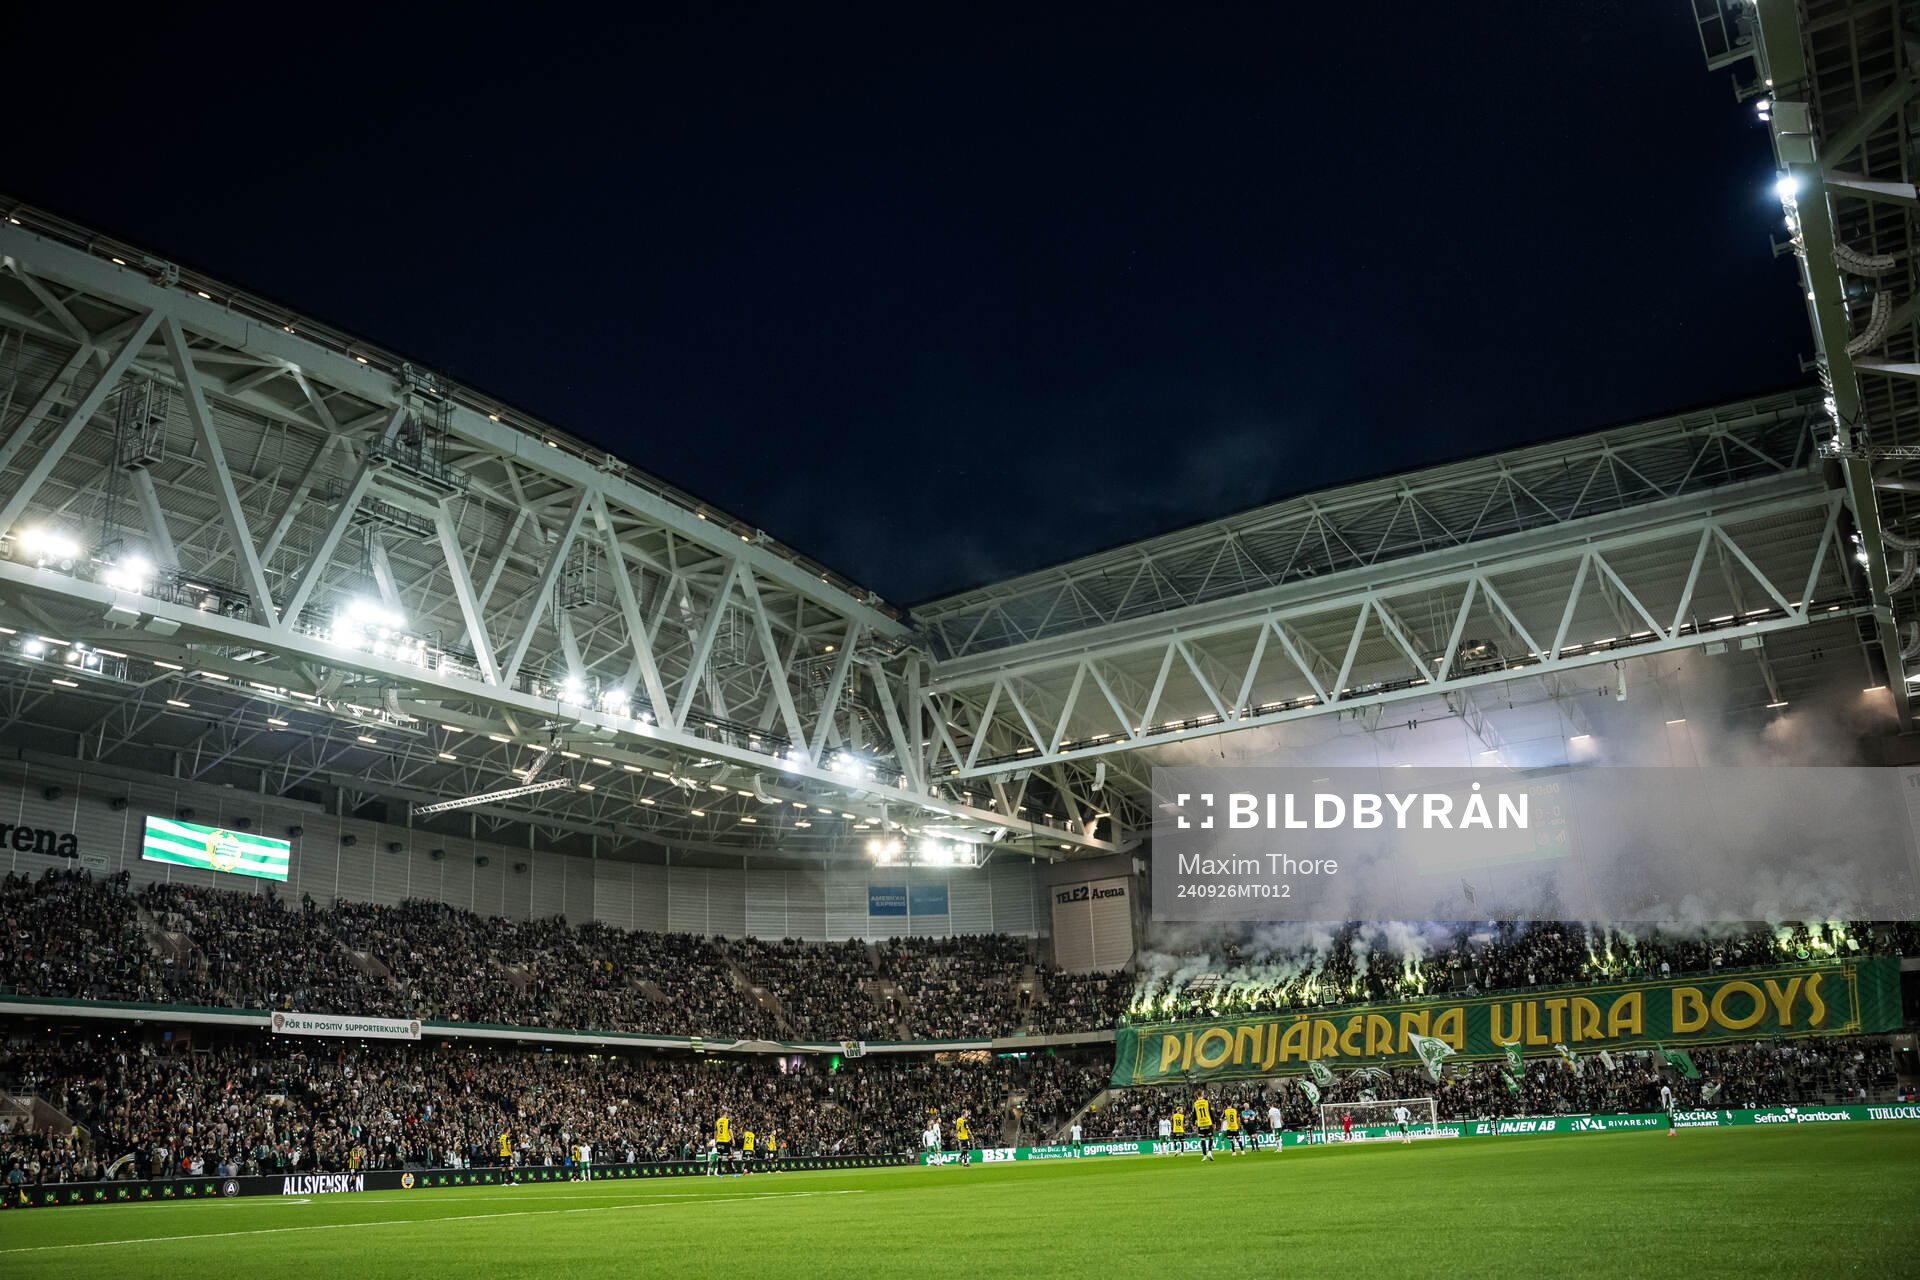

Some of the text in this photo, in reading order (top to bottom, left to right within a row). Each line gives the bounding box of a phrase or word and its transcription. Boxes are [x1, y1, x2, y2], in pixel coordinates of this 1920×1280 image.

[1056, 886, 1125, 904] TELE2 Arena
[285, 1019, 409, 1034] FÖR EN POSITIV SUPPORTERKULTUR
[1159, 972, 1826, 1074] PIONJÄRERNA ULTRA BOYS
[1198, 1107, 1207, 1118] 11
[1673, 1111, 1718, 1121] SASCHAS
[1754, 1109, 1851, 1124] Sefina pantbank
[1476, 1121, 1537, 1134] ELINJEN
[1538, 1120, 1556, 1131] AB
[1608, 1118, 1657, 1127] RIVARE.NU
[982, 1148, 1017, 1159] BST
[1084, 1141, 1139, 1156] ggmgastro
[283, 1174, 364, 1195] ALLSVENSKN
